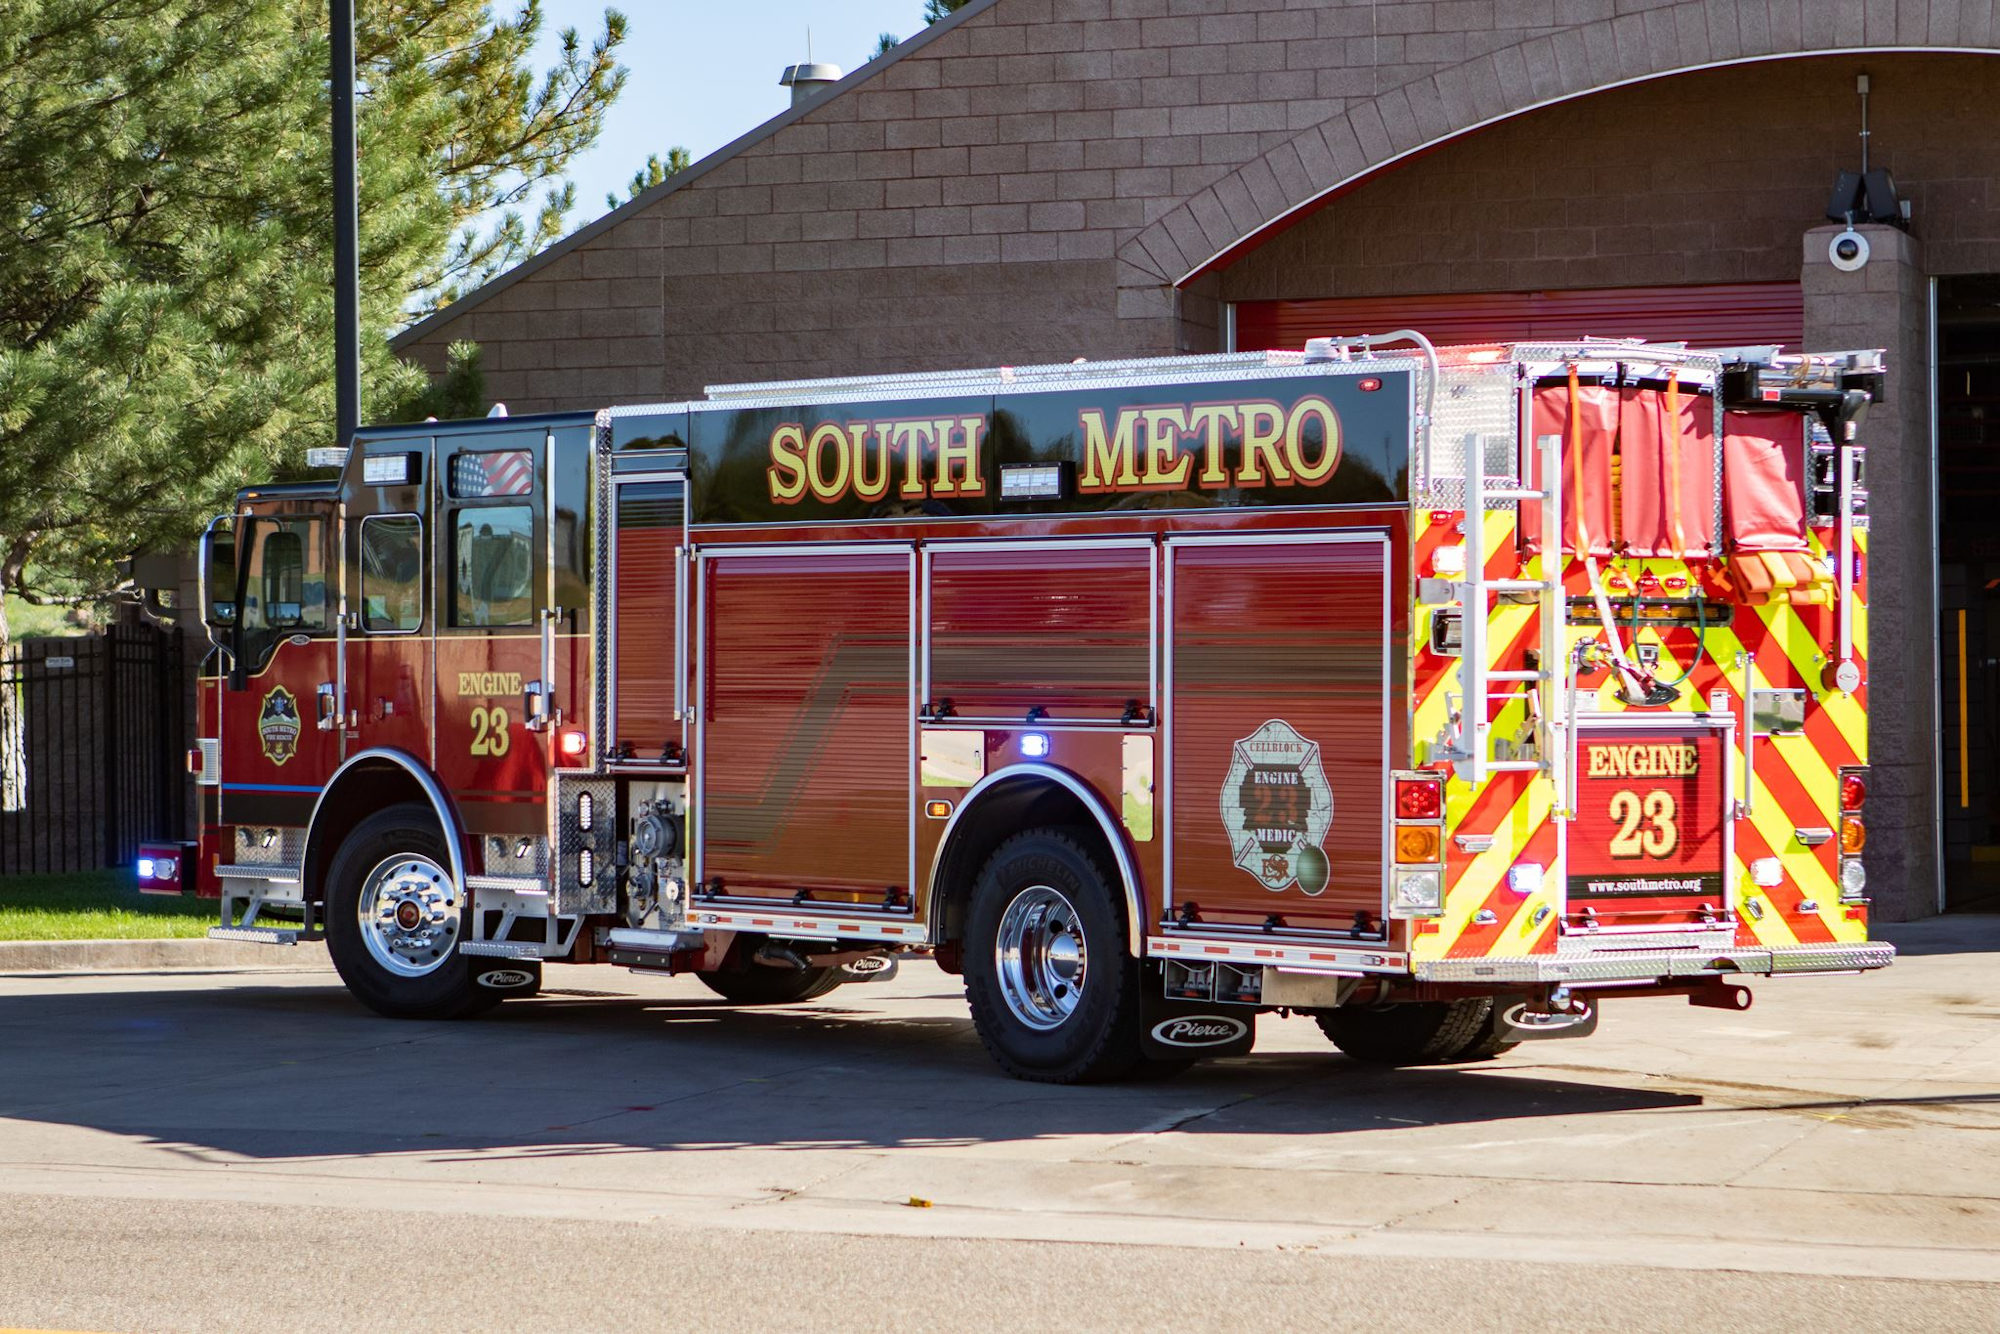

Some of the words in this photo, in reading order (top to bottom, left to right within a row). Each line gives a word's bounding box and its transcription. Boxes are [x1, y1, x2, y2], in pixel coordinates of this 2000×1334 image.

[767, 415, 985, 504] SOUTH
[1079, 396, 1343, 493] METRO
[458, 672, 522, 696] ENGINE
[470, 706, 510, 757] 23
[1249, 742, 1303, 753] CELLBLOCK
[1587, 745, 1699, 778] ENGINE
[1254, 771, 1299, 785] ENGINE
[1253, 786, 1299, 825] 23
[1609, 789, 1679, 858] 23
[1256, 828, 1297, 843] MEDIC
[1006, 857, 1081, 890] MICHELIN
[1587, 877, 1703, 893] www.southmetro.org
[853, 958, 881, 970] Pierce
[490, 971, 523, 984] Pierce
[1169, 1020, 1230, 1040] Pierce
